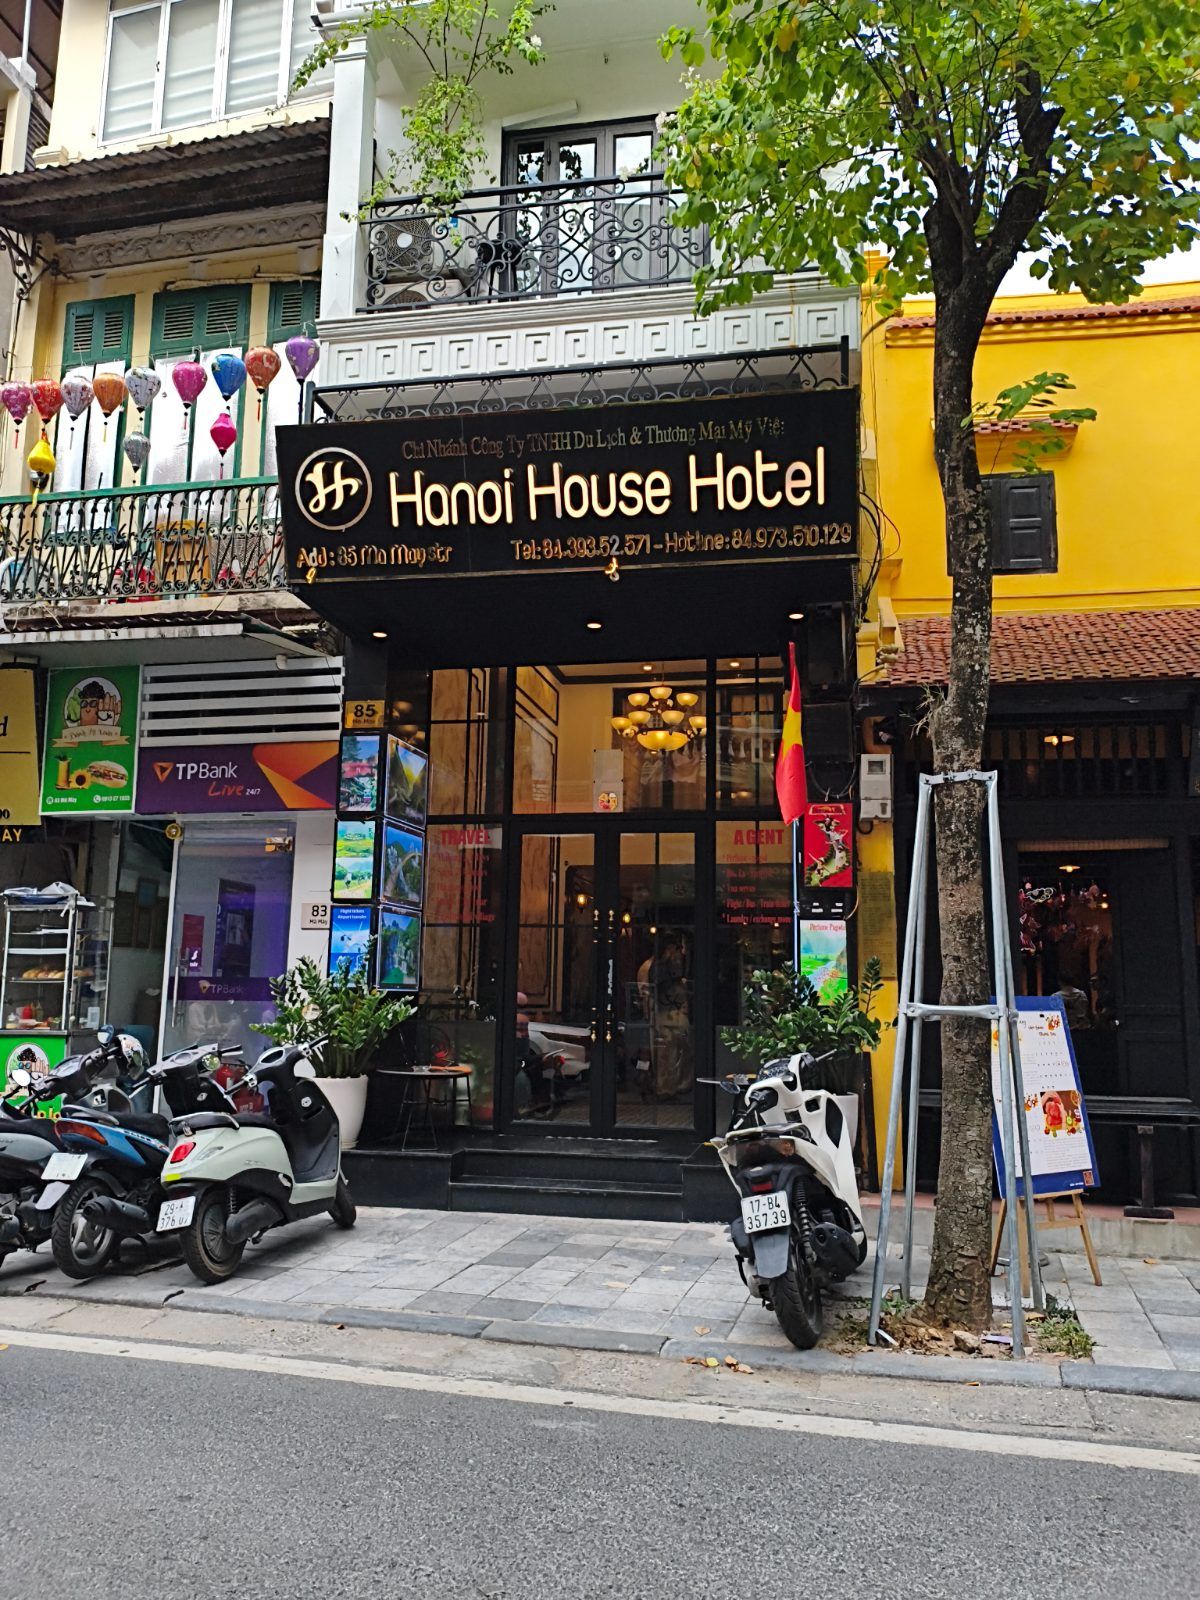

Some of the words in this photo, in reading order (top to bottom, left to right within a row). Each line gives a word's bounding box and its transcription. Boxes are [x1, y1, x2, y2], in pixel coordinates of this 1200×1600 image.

[507, 433, 524, 458] Ty
[526, 431, 571, 453] TNHH
[574, 430, 594, 449] Du
[629, 425, 642, 445] &
[389, 467, 514, 528] Hanoi
[526, 462, 672, 522] House
[688, 446, 826, 513] Hotel
[354, 704, 377, 718] 85
[176, 762, 238, 780] TPBank
[208, 781, 243, 796] Live
[440, 829, 492, 845] TRAVEL
[733, 829, 784, 845] AGENT
[311, 904, 328, 917] 83
[750, 1195, 781, 1213] 17-B4
[746, 1210, 787, 1230] 357.39
